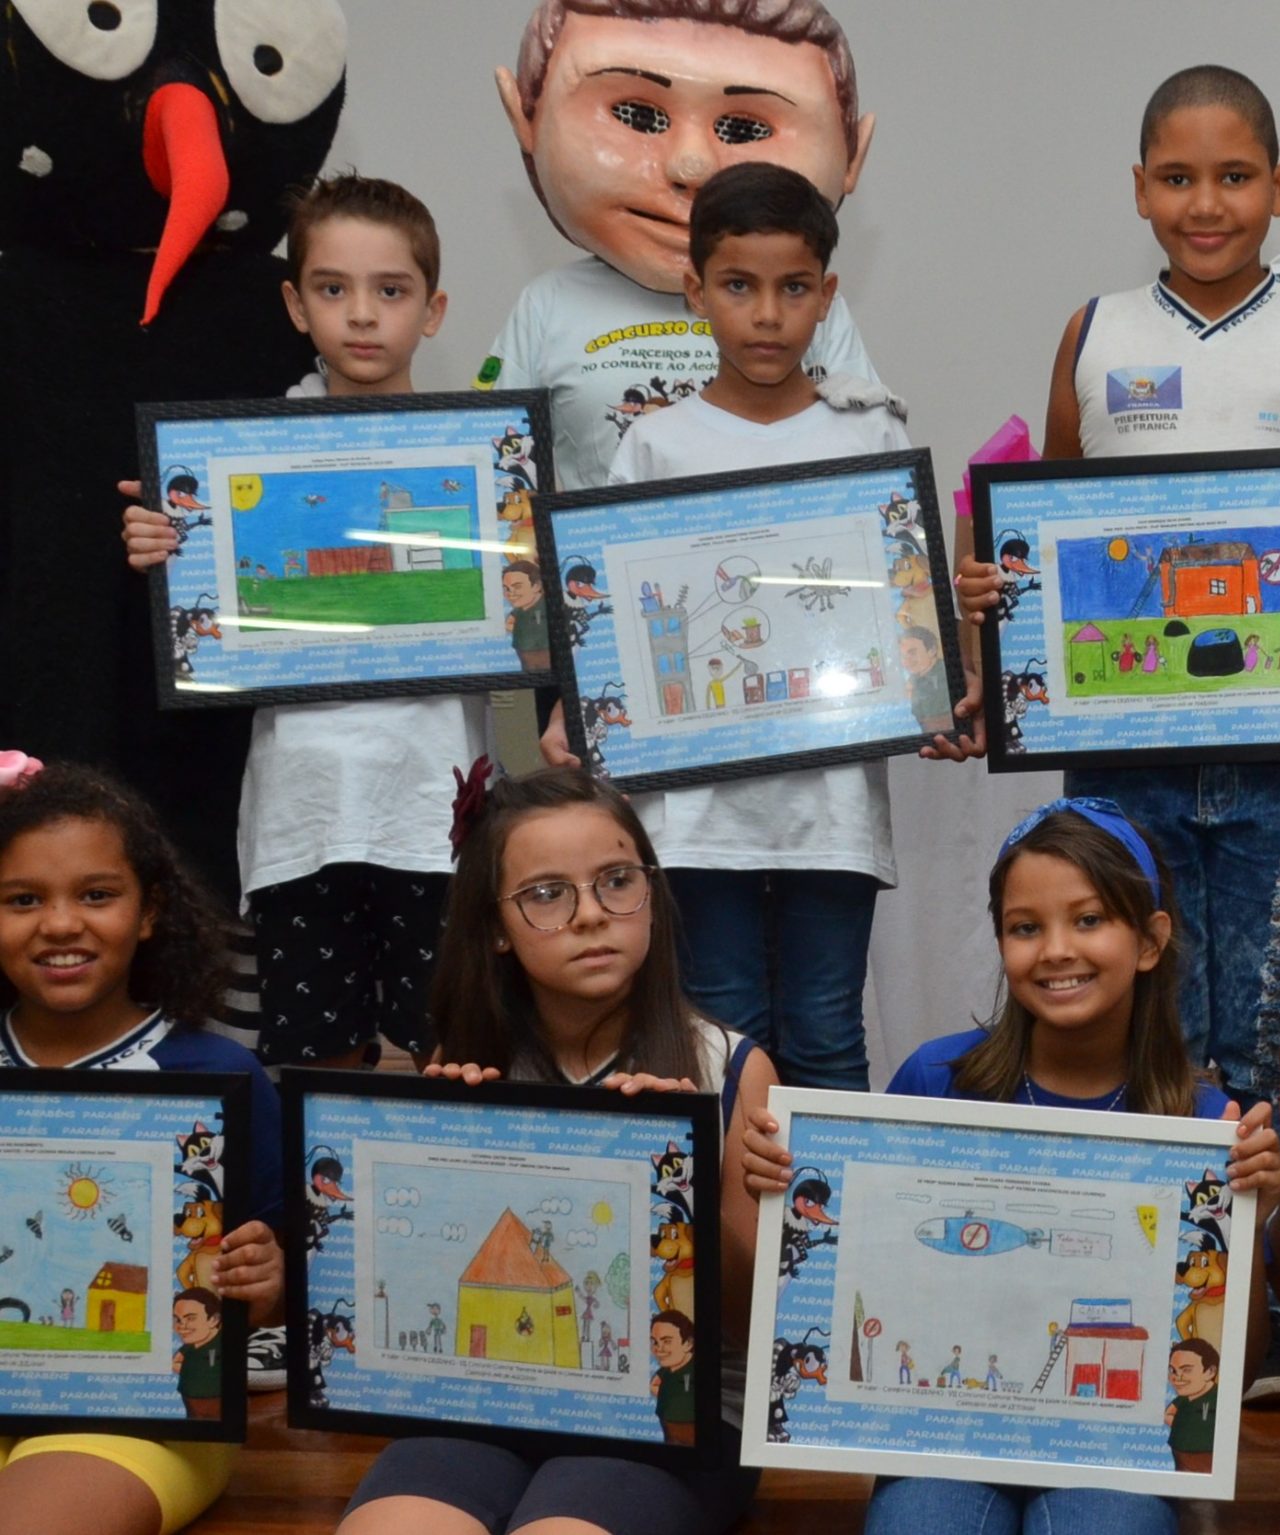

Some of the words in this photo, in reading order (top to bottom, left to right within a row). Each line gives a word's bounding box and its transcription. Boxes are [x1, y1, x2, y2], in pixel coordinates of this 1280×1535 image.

[1221, 291, 1276, 333] FRANCA
[585, 320, 689, 354] CONCURSO
[694, 350, 712, 358] DA
[581, 361, 598, 374] NO
[601, 361, 663, 371] COMBATE
[666, 362, 685, 371] AO
[1114, 413, 1179, 425] PREFEITURA
[1258, 412, 1279, 423] MEU
[1117, 424, 1130, 434] DE
[810, 1134, 869, 1146] PARABÉNS
[887, 1135, 945, 1147] PARABÉNS
[857, 1151, 916, 1163] PARABÉNS
[951, 1146, 1009, 1158] PARABÉNS
[1028, 1147, 1086, 1159] PARABÉNS
[923, 1158, 981, 1170] PARABÉNS
[1094, 1153, 1152, 1165] PARABÉNS
[1165, 1159, 1224, 1171] PARABÉNS
[999, 1163, 1057, 1175] PARABÉNS
[1072, 1168, 1130, 1180] PARABÉNS
[831, 1420, 890, 1432] PARABÉNS
[925, 1415, 983, 1426] PARABÉNS
[1078, 1424, 1136, 1435] PARABÉNS
[858, 1436, 916, 1448] PARABÉNS
[906, 1430, 964, 1442] PARABÉNS
[973, 1432, 1031, 1444] PARABÉNS
[1049, 1439, 1107, 1451] PARABÉNS
[999, 1448, 1057, 1460] PARABÉNS
[1075, 1455, 1134, 1467] PARABÉNS
